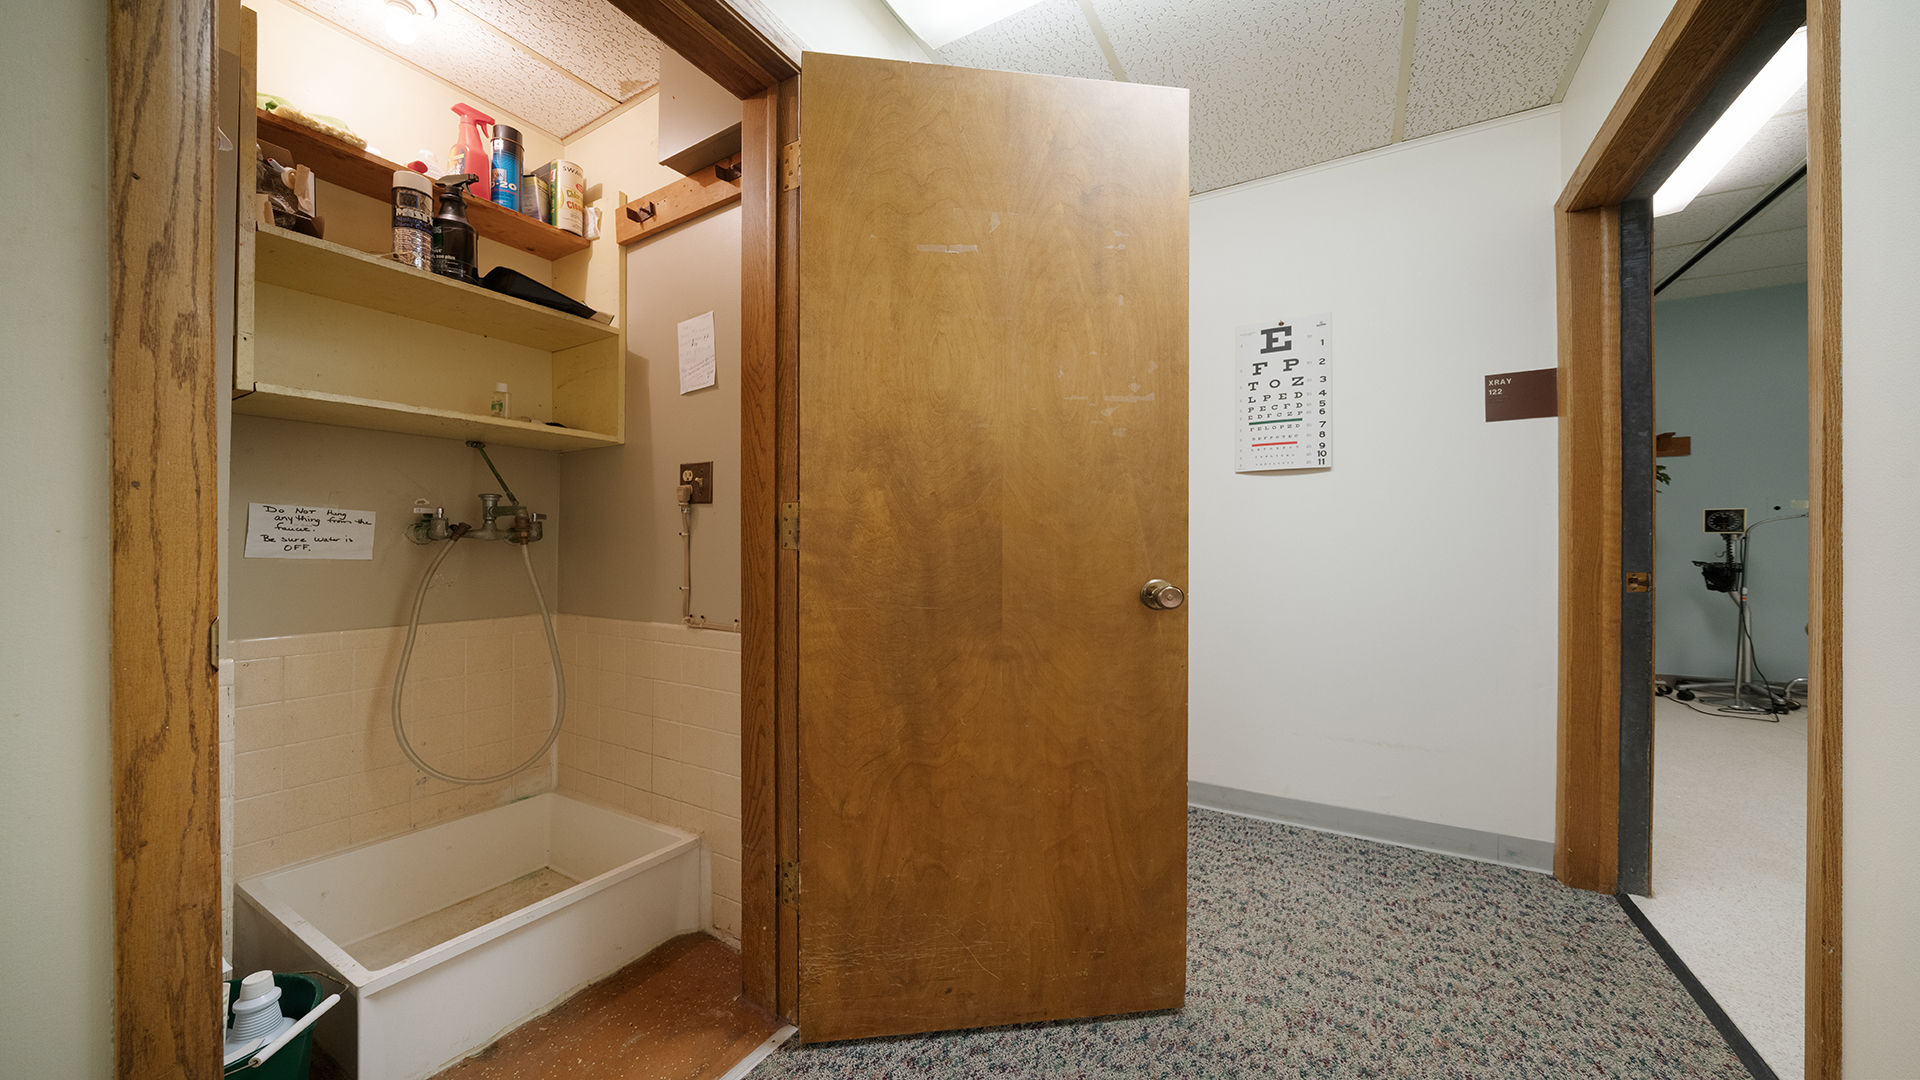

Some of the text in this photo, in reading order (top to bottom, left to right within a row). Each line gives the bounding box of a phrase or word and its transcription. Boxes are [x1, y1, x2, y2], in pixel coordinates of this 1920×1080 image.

[1260, 325, 1292, 354] E
[1252, 362, 1268, 376] F
[1283, 358, 1300, 372] P
[1488, 378, 1512, 386] XRAY
[1488, 388, 1503, 396] 122
[262, 505, 285, 514] Do
[326, 516, 352, 525] from
[354, 518, 373, 526] the
[260, 533, 277, 543] Be
[344, 535, 354, 543] is
[283, 544, 311, 552] OFF.
